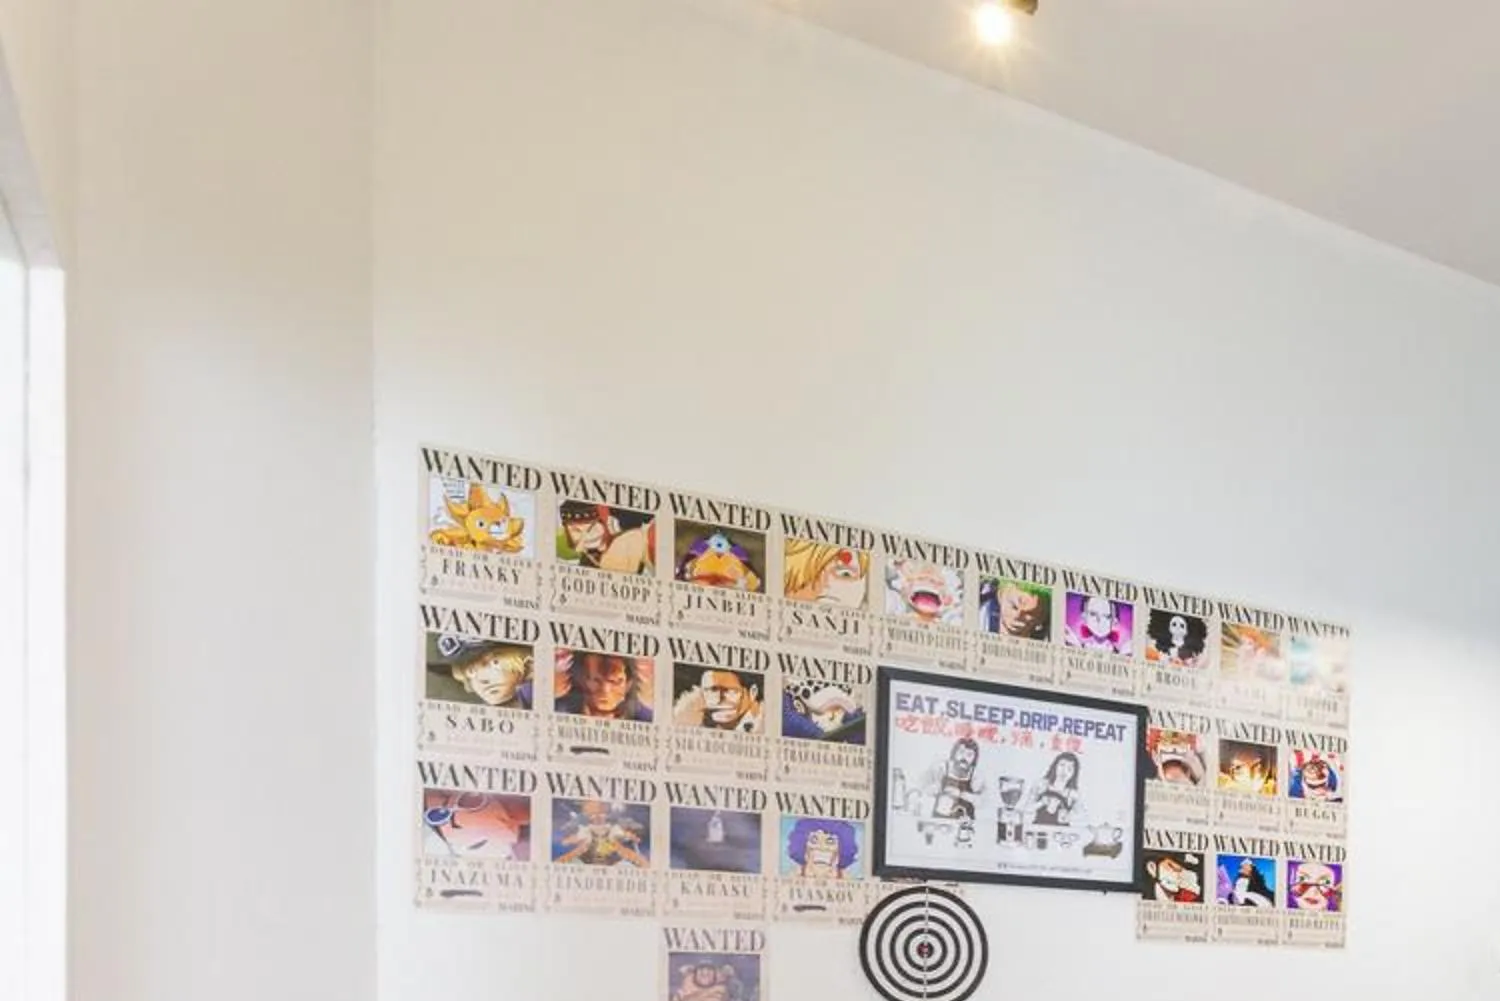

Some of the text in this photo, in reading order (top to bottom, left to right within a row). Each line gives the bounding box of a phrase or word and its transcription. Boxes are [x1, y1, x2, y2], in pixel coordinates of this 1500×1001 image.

[421, 447, 542, 491] WANTED
[550, 471, 663, 512] WANTED
[669, 492, 771, 531] WANTED
[780, 513, 875, 551] WANTED
[882, 532, 970, 570] WANTED
[442, 559, 521, 585] FRANKY
[975, 551, 1057, 586] WANTED
[562, 576, 651, 603] GOD USOPP
[1062, 569, 1138, 601] WANTED
[684, 594, 756, 617] JINBEI
[1141, 586, 1213, 617] WANTED
[1217, 601, 1284, 630] WANTED
[420, 604, 540, 643] WANTED
[791, 610, 860, 635] SANJI
[549, 621, 660, 657] WANTED
[668, 637, 771, 671] WANTED
[777, 652, 872, 685] WANTED
[445, 714, 515, 735] SABO
[1215, 715, 1282, 747] WANTED
[1285, 724, 1348, 753] WANTED
[417, 761, 537, 794] WANTED
[545, 772, 657, 804] WANTED
[665, 782, 768, 811] WANTED
[775, 791, 871, 820] WANTED
[1213, 833, 1280, 856] WANTED
[1283, 840, 1347, 862] WANTED
[431, 869, 523, 888] INAZUMA
[680, 881, 750, 898] KARASU
[788, 887, 854, 903] IVANKOV
[664, 927, 766, 951] WANTED
